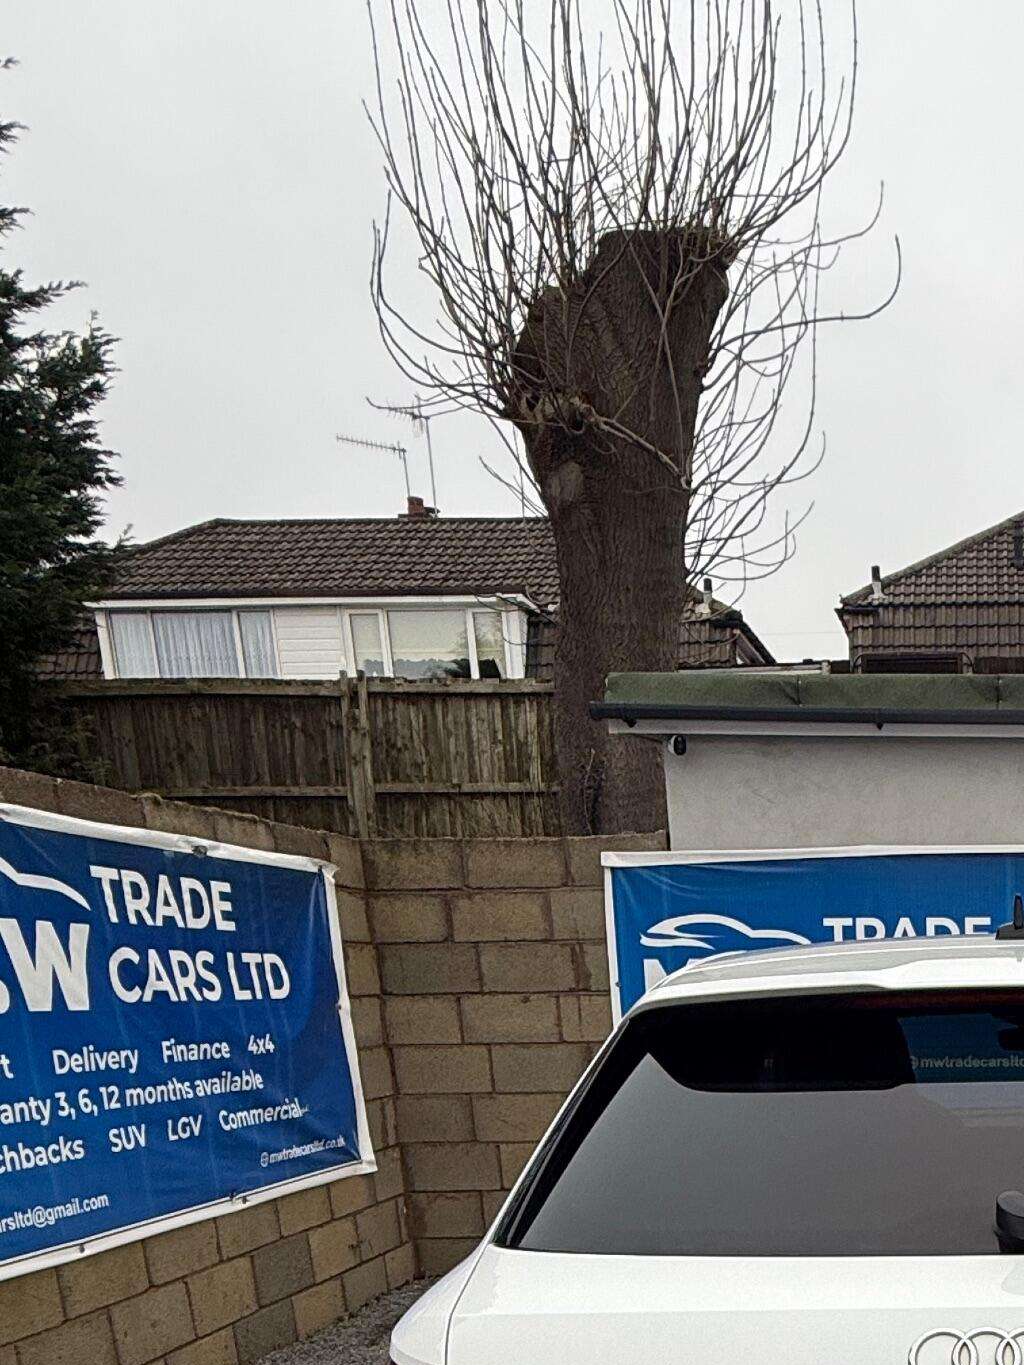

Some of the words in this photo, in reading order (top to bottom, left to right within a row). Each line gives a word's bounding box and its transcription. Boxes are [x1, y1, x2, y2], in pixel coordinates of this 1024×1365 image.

[89, 864, 236, 932] TRADE
[108, 946, 223, 1003] CARS
[226, 952, 292, 1001] LTD
[52, 1044, 139, 1075] Delivery
[161, 1037, 231, 1064] Finance
[248, 1033, 275, 1055] 4x4
[54, 1090, 77, 1121] 3,
[78, 1087, 99, 1117] 6,
[99, 1084, 121, 1111] 12
[125, 1077, 194, 1107] months
[195, 1068, 265, 1098] available
[108, 1123, 147, 1153] SUV
[167, 1114, 203, 1141] LGV
[0, 1193, 110, 1233] rsltd@gmail.com
